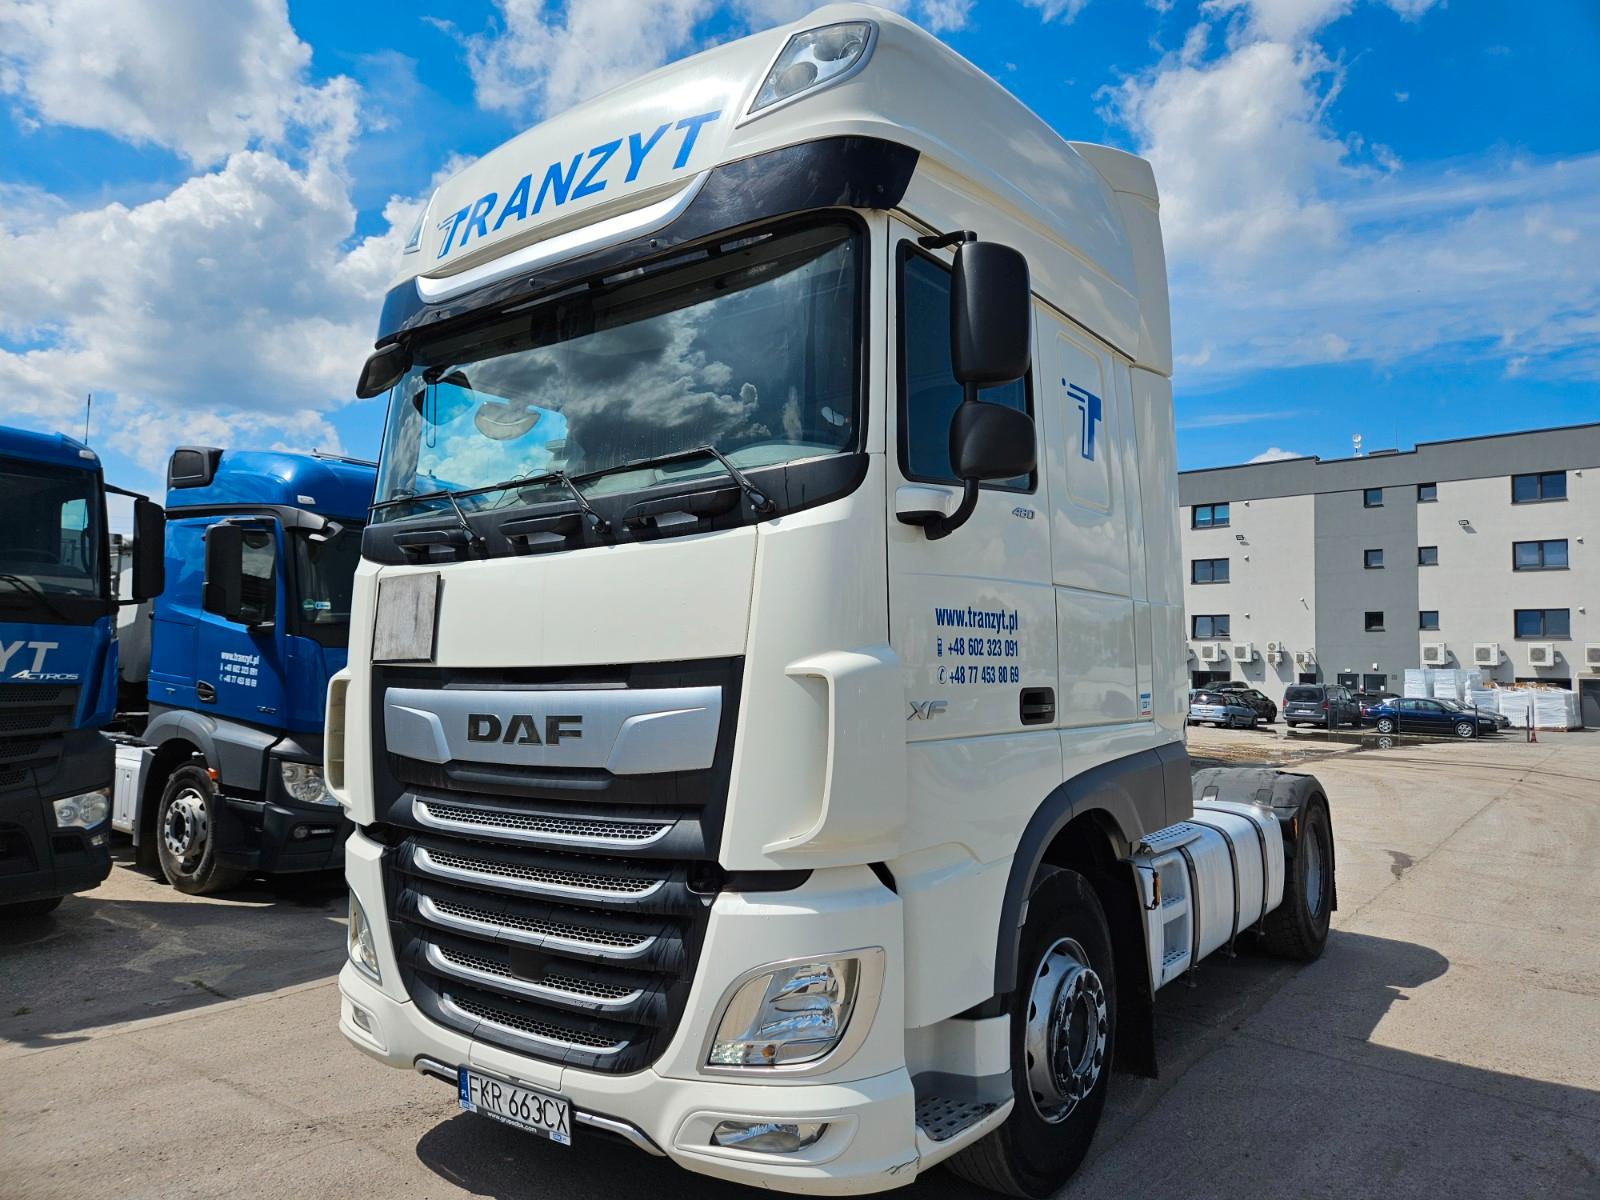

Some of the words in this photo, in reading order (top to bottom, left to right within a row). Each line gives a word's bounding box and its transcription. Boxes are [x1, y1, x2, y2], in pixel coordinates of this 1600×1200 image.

[436, 109, 721, 259] TRANZYT
[935, 606, 1018, 634] www.tranzyt.pl
[947, 637, 965, 656] +48
[968, 639, 985, 656] 602
[986, 639, 1002, 657] 323
[1004, 640, 1019, 657] 091
[949, 665, 966, 684] +48
[968, 666, 979, 684] 77
[981, 666, 996, 684] 453
[998, 666, 1008, 684] 80
[1009, 666, 1020, 684] 69
[906, 700, 948, 721] XF
[467, 713, 584, 746] DAF
[469, 1074, 503, 1113] FKR
[508, 1089, 568, 1135] 663CX
